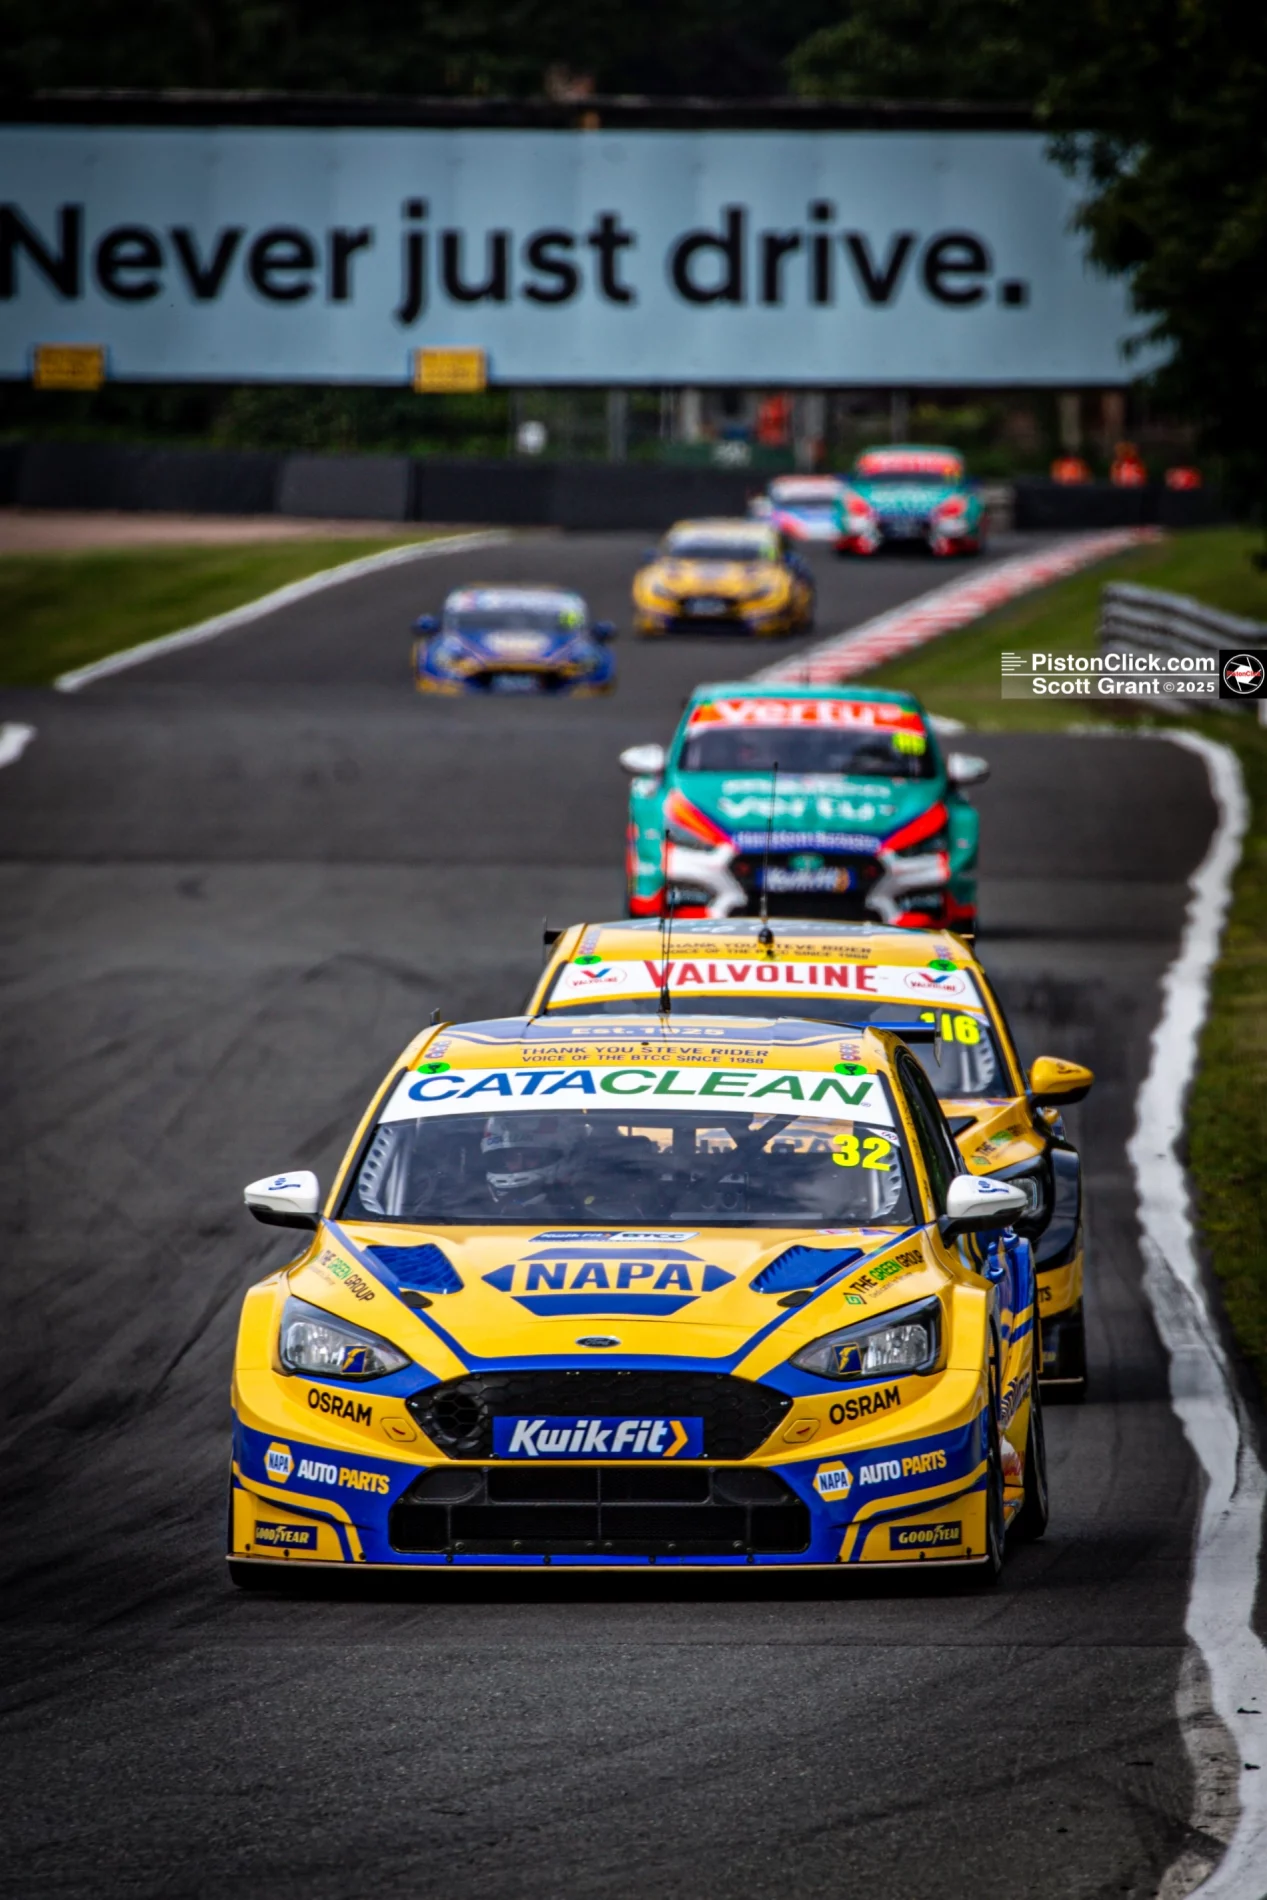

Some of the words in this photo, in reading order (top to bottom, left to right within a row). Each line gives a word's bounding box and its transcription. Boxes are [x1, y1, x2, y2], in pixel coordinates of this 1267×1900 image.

[0, 203, 373, 305] Never
[394, 196, 636, 330] just
[667, 199, 1029, 307] drive.
[643, 960, 878, 992] VALVOLINE
[572, 1027, 634, 1035] Est.
[642, 1028, 725, 1036] 1925
[522, 1046, 587, 1056] THANK
[595, 1046, 635, 1054] YOU
[641, 1047, 704, 1055] STEVE
[711, 1048, 769, 1057] RIDER
[730, 1057, 765, 1065] 1988
[408, 1069, 874, 1106] CATACLEAN
[831, 1133, 891, 1172] 32
[525, 1262, 694, 1292] NAPA
[849, 1274, 878, 1294] THE
[869, 1259, 903, 1281] GREEN
[895, 1249, 923, 1268] GROUP
[344, 1273, 376, 1302] GROUP
[308, 1388, 372, 1427] OSRAM
[829, 1386, 901, 1426] OSRAM
[267, 1451, 290, 1474] NAPA
[297, 1459, 337, 1485] AUTO
[338, 1467, 390, 1495] PARTS
[858, 1459, 901, 1486] AUTO
[902, 1449, 948, 1477] PARTS
[818, 1471, 848, 1493] NAPA
[255, 1525, 310, 1545] GOODYEAR
[898, 1524, 960, 1546] GOODYEAR
